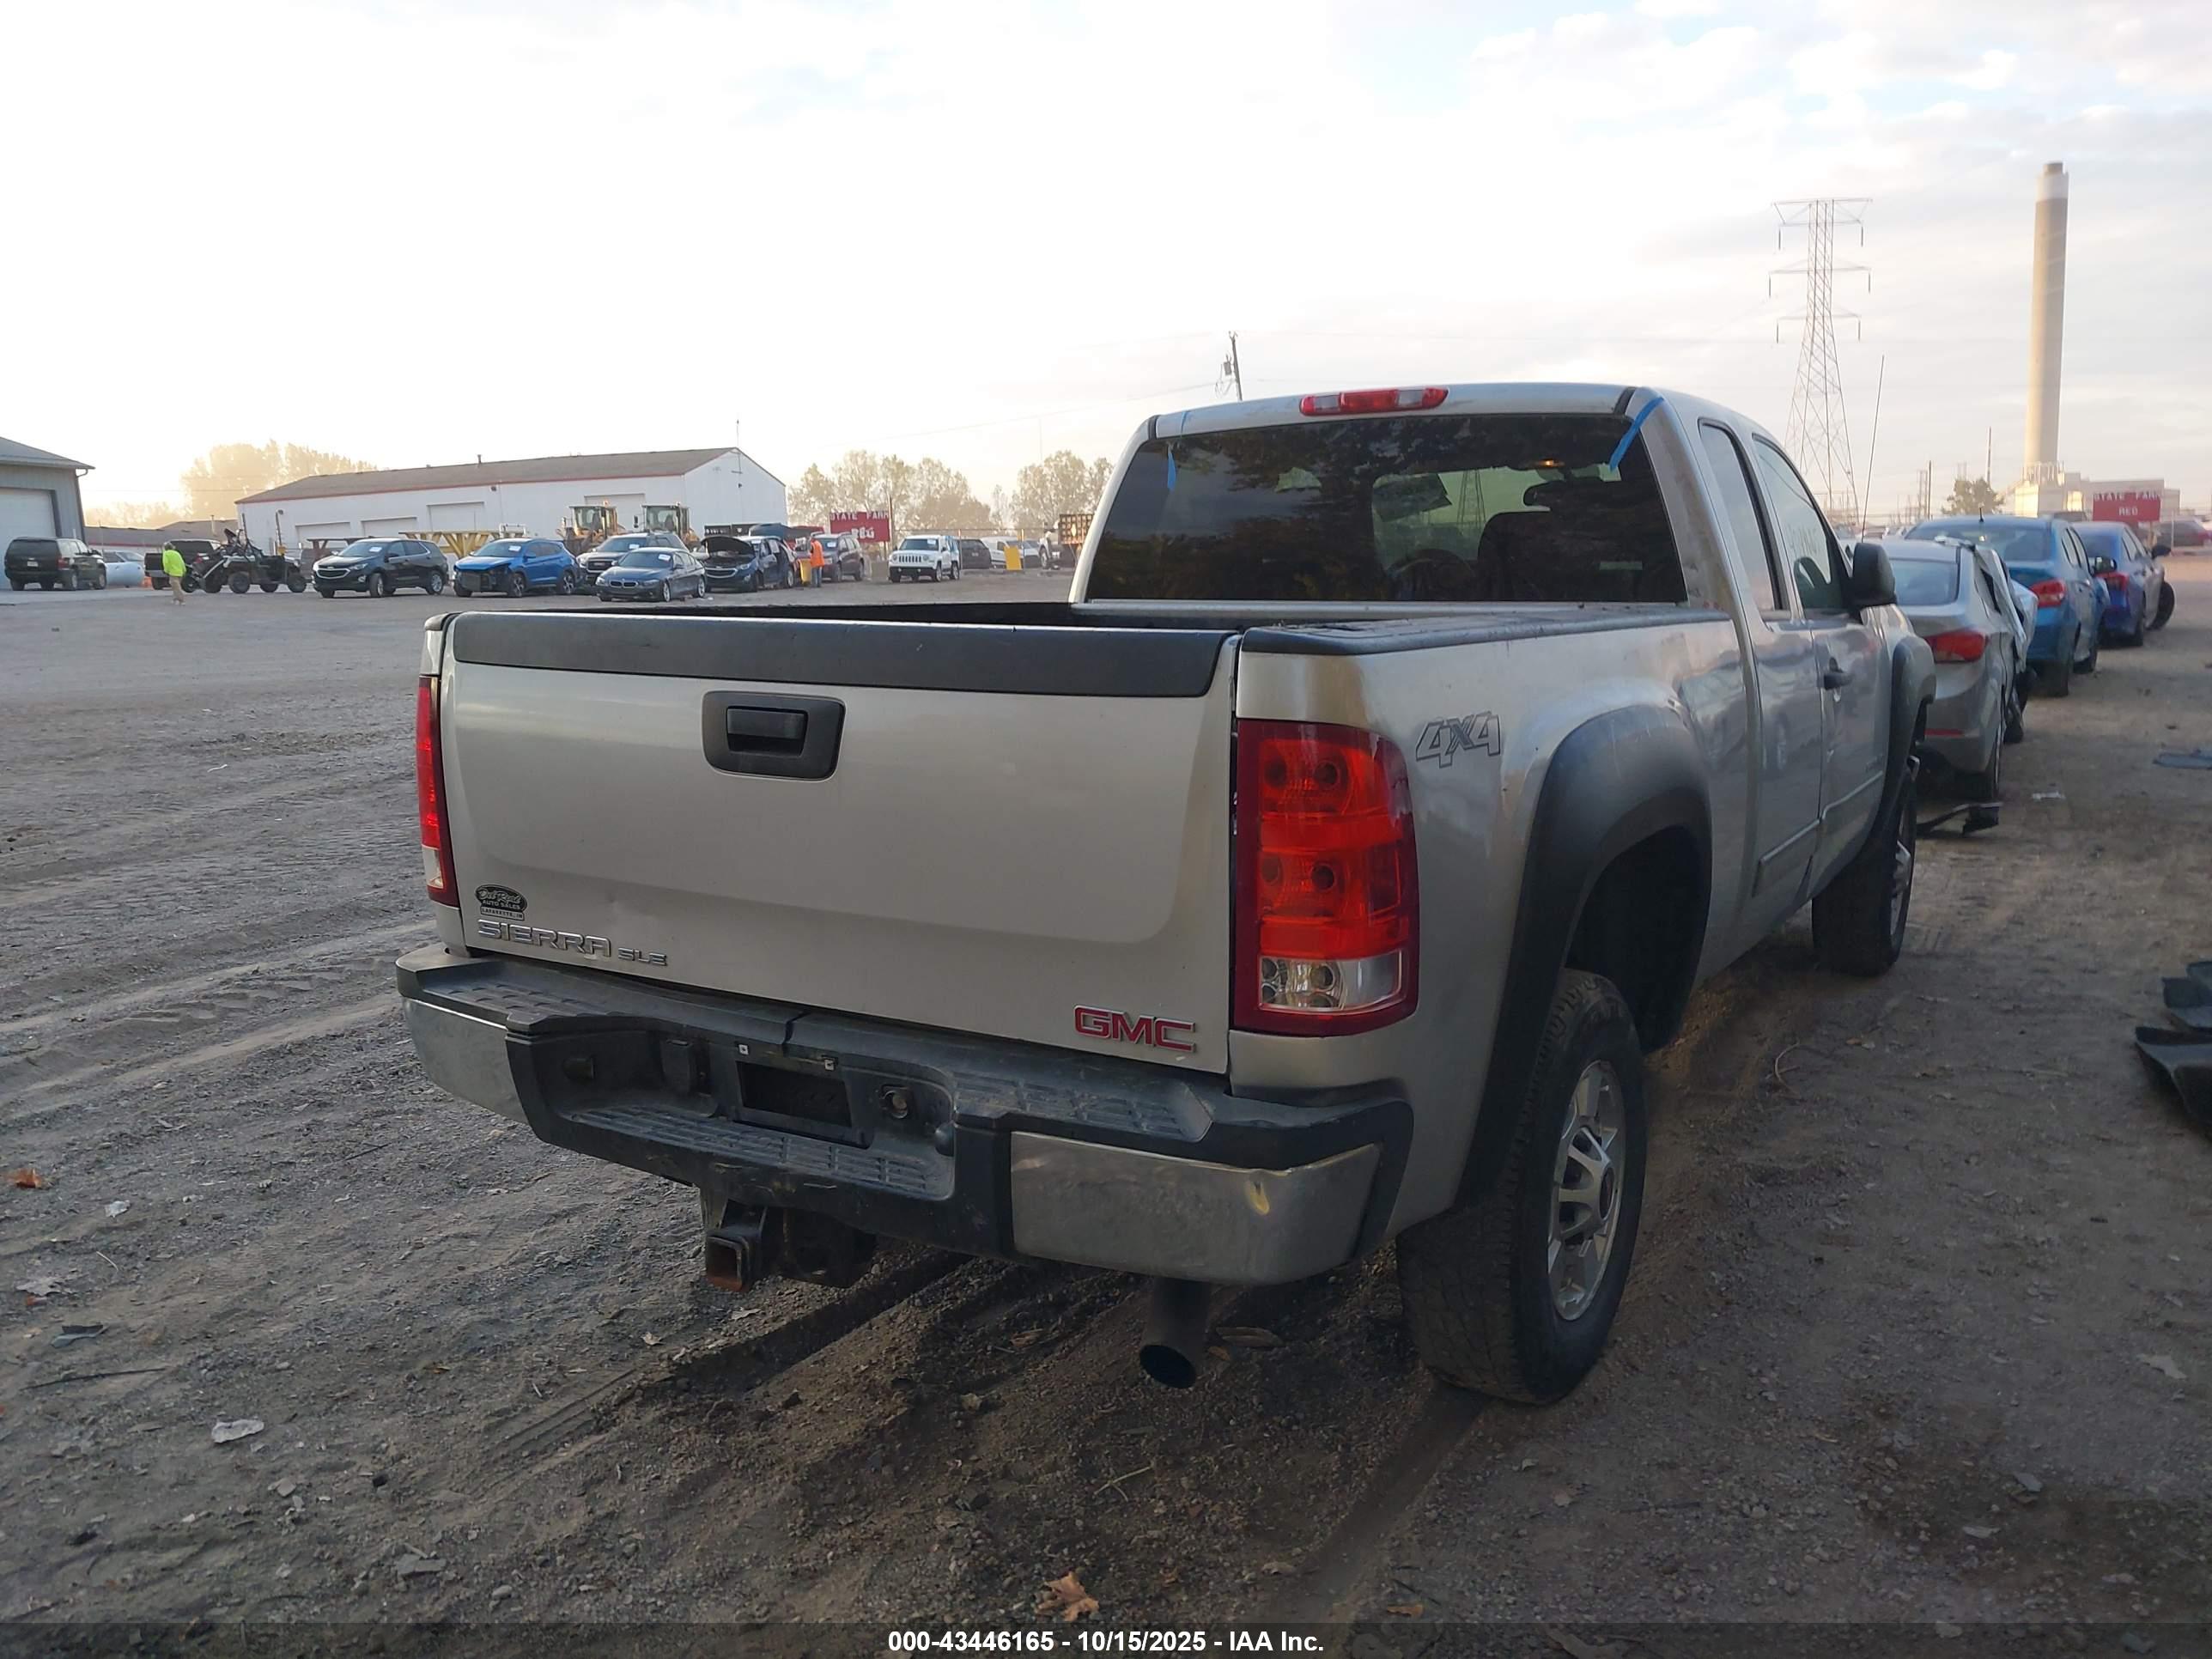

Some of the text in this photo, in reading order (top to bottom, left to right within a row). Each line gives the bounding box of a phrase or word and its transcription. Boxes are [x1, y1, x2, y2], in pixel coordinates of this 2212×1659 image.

[477, 919, 668, 966] SIERRA SLE
[1073, 1005, 1197, 1053] GMC
